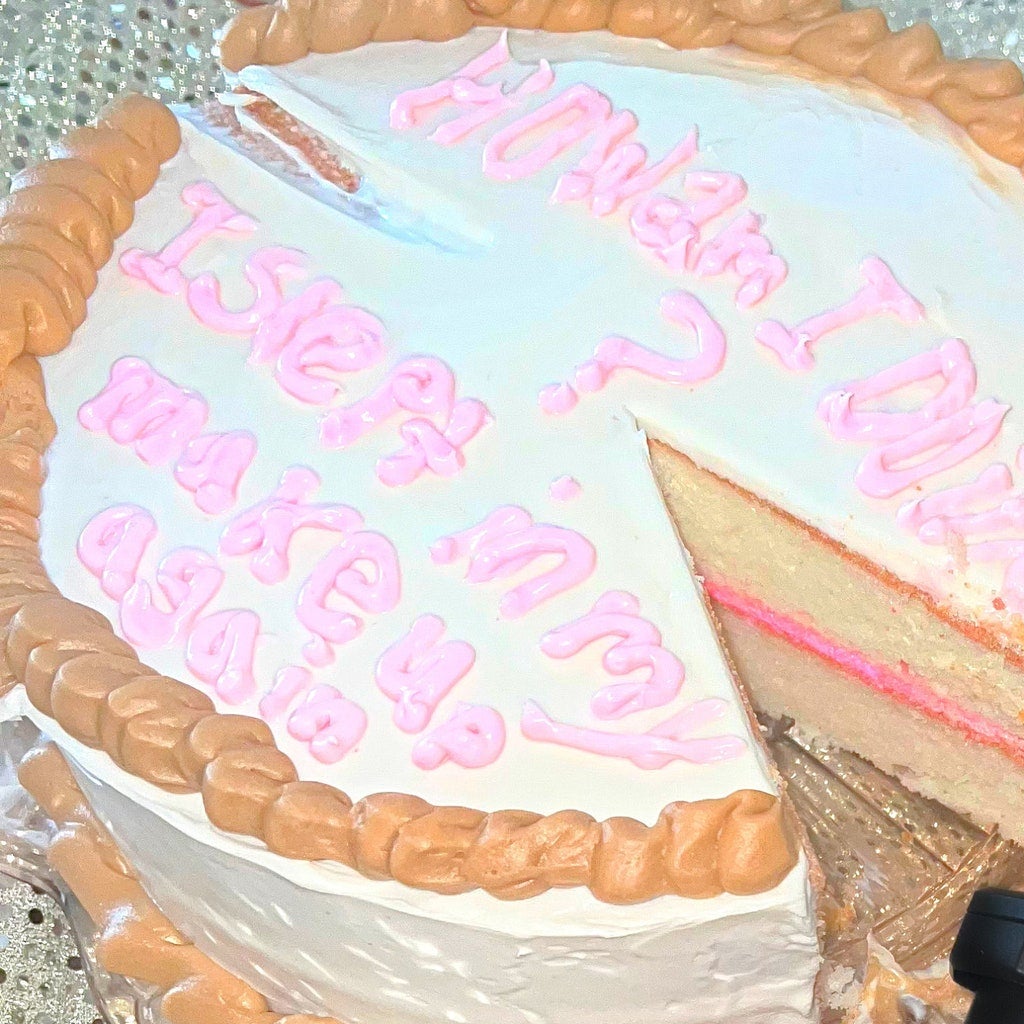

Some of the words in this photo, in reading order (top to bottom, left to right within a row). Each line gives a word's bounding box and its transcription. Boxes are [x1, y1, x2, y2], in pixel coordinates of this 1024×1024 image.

[539, 290, 727, 415] ?
[629, 171, 788, 309] am
[755, 255, 925, 371] I
[118, 181, 259, 295] I
[430, 474, 597, 618] in
[521, 590, 748, 770] my
[76, 502, 367, 765] again
